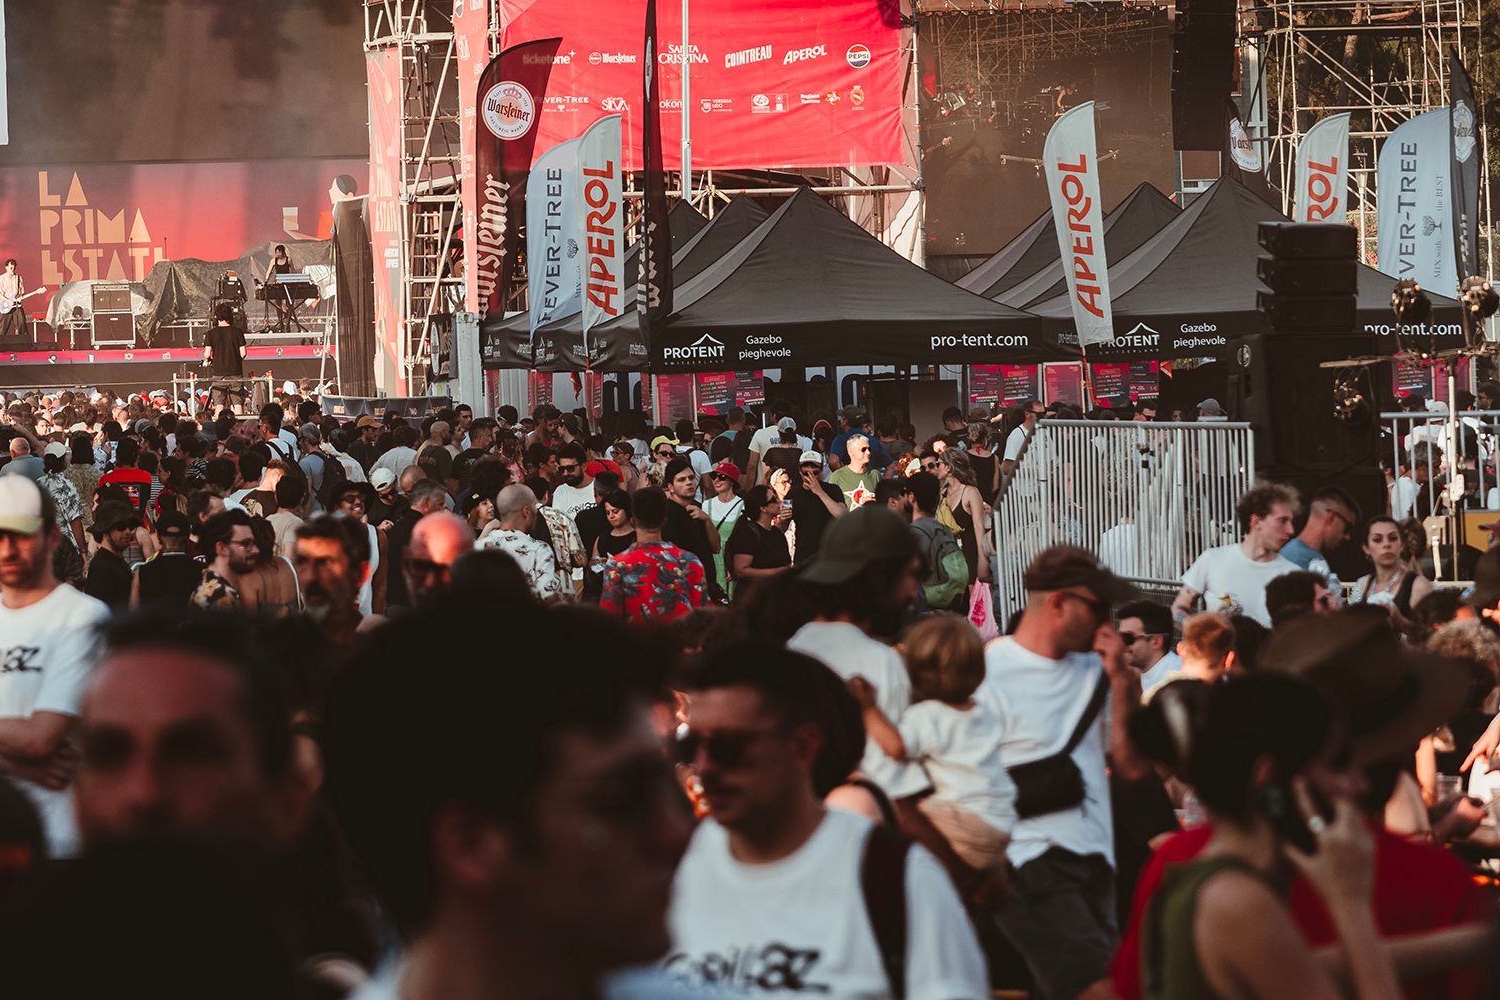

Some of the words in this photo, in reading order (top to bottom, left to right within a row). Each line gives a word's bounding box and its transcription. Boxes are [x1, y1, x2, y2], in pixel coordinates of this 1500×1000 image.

[725, 45, 773, 68] COINTREAU
[783, 45, 828, 65] APEROL
[487, 98, 530, 122] Warsteiner
[38, 171, 88, 206] LA
[40, 207, 151, 245] PRIMA
[583, 160, 618, 316] APEROL
[1057, 154, 1104, 318] APEROL
[1181, 322, 1217, 333] Gazebo
[746, 334, 782, 345] Gazebo
[931, 333, 1029, 349] pro-tent.com
[1173, 335, 1226, 348] pieghevole
[664, 345, 725, 359] PROTENT
[739, 347, 791, 360] pieghevole
